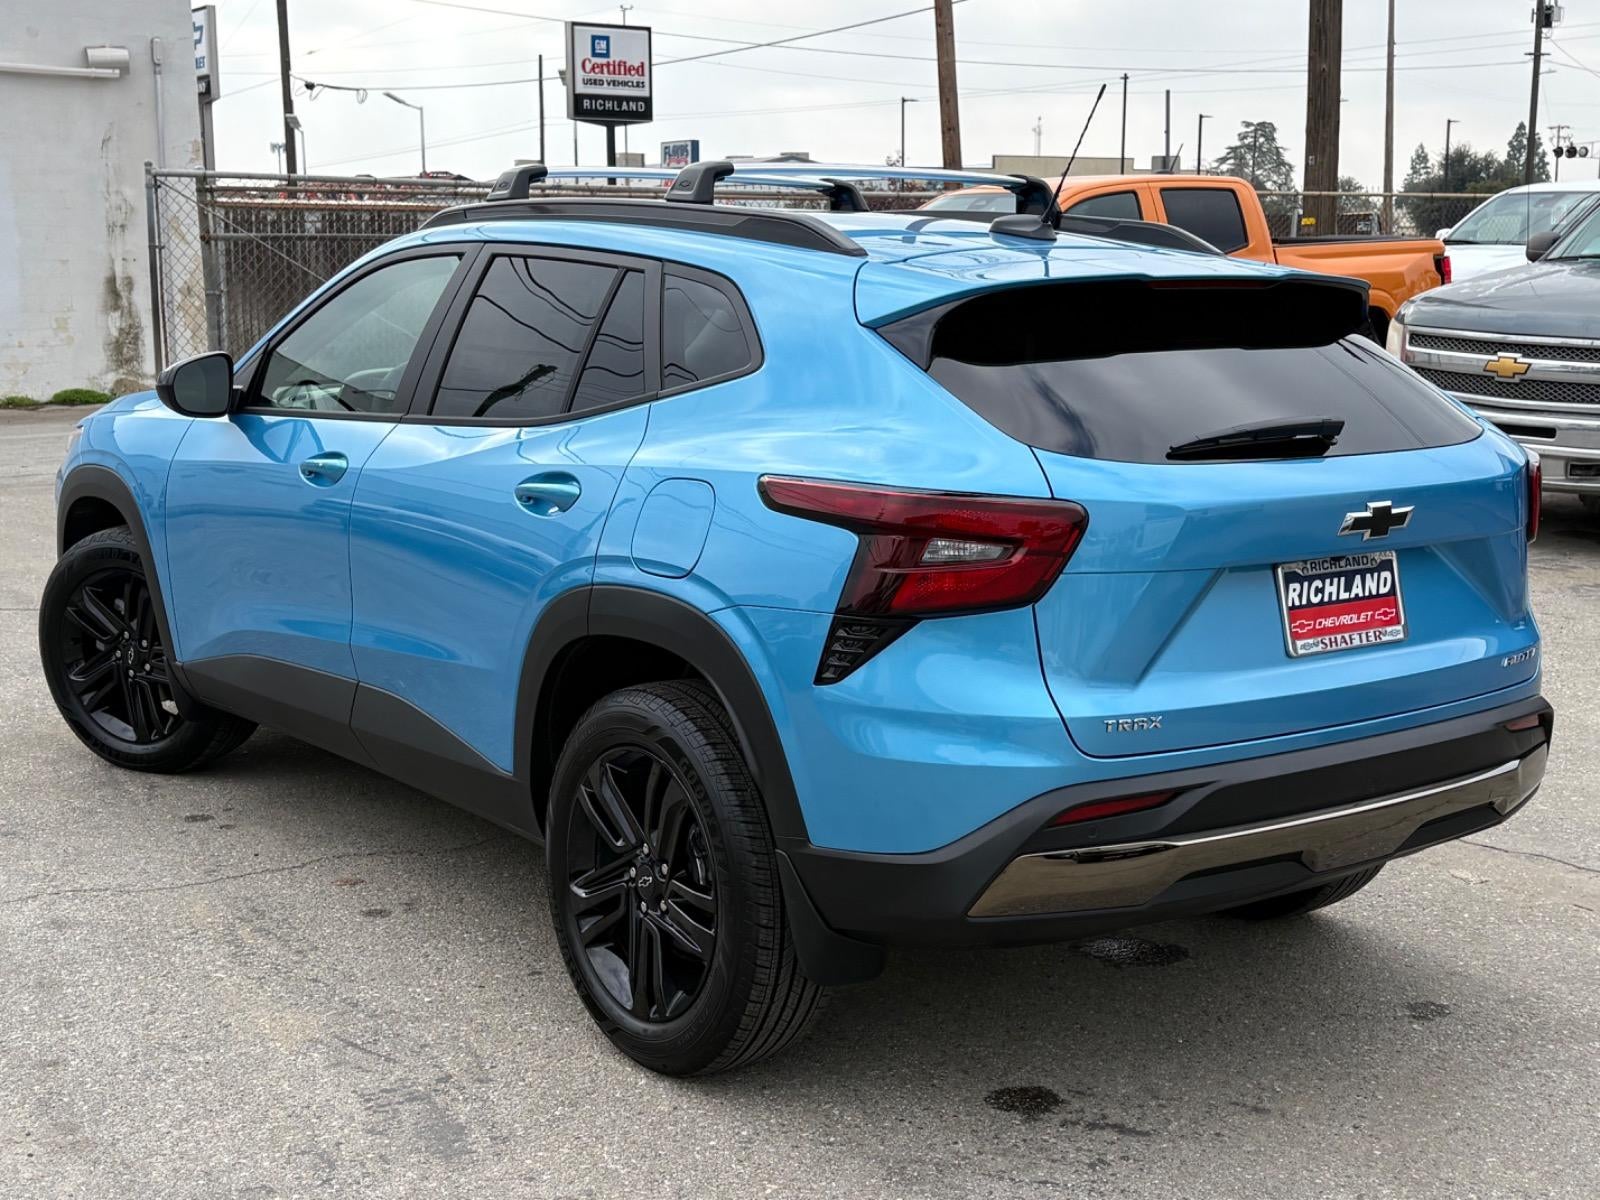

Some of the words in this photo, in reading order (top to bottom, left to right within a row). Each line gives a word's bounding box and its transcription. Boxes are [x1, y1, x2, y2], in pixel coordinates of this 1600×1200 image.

[595, 39, 607, 50] GM
[581, 57, 645, 77] Certified
[582, 78, 605, 87] USED
[606, 79, 646, 89] VEHICLES
[583, 98, 646, 112] RICHLAND
[1310, 554, 1369, 572] RICHLAND
[1287, 570, 1393, 607] RICHLAND
[1315, 611, 1373, 629] CHEVROLET
[1320, 630, 1383, 650] SHAFTER
[1103, 715, 1163, 733] TRAX
